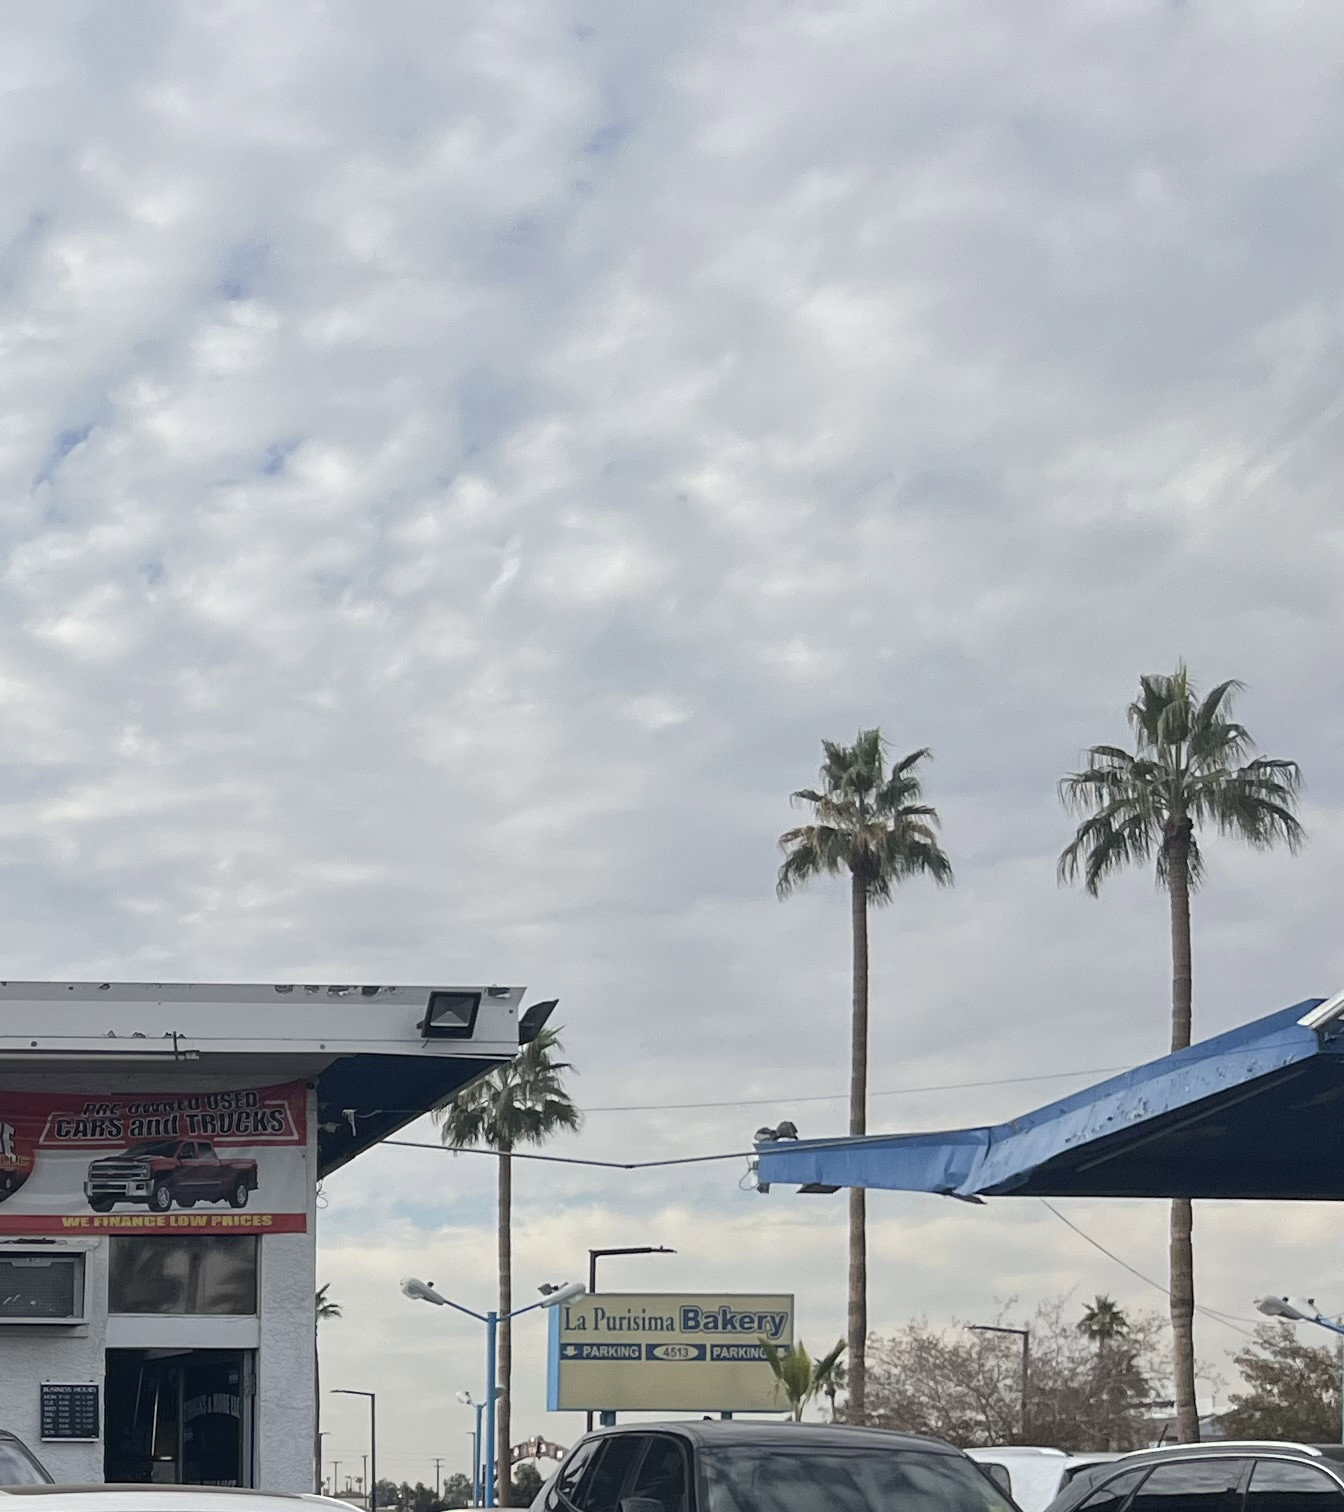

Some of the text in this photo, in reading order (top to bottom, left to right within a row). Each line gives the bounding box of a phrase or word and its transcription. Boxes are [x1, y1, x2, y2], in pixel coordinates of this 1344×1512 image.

[206, 1090, 259, 1111] USED
[55, 1108, 284, 1139] CARS and TRUCKS
[61, 1214, 273, 1228] WE FINANCE LOW PRICES
[564, 1306, 787, 1338] La Purisima Bakery
[583, 1345, 640, 1359] PARKING
